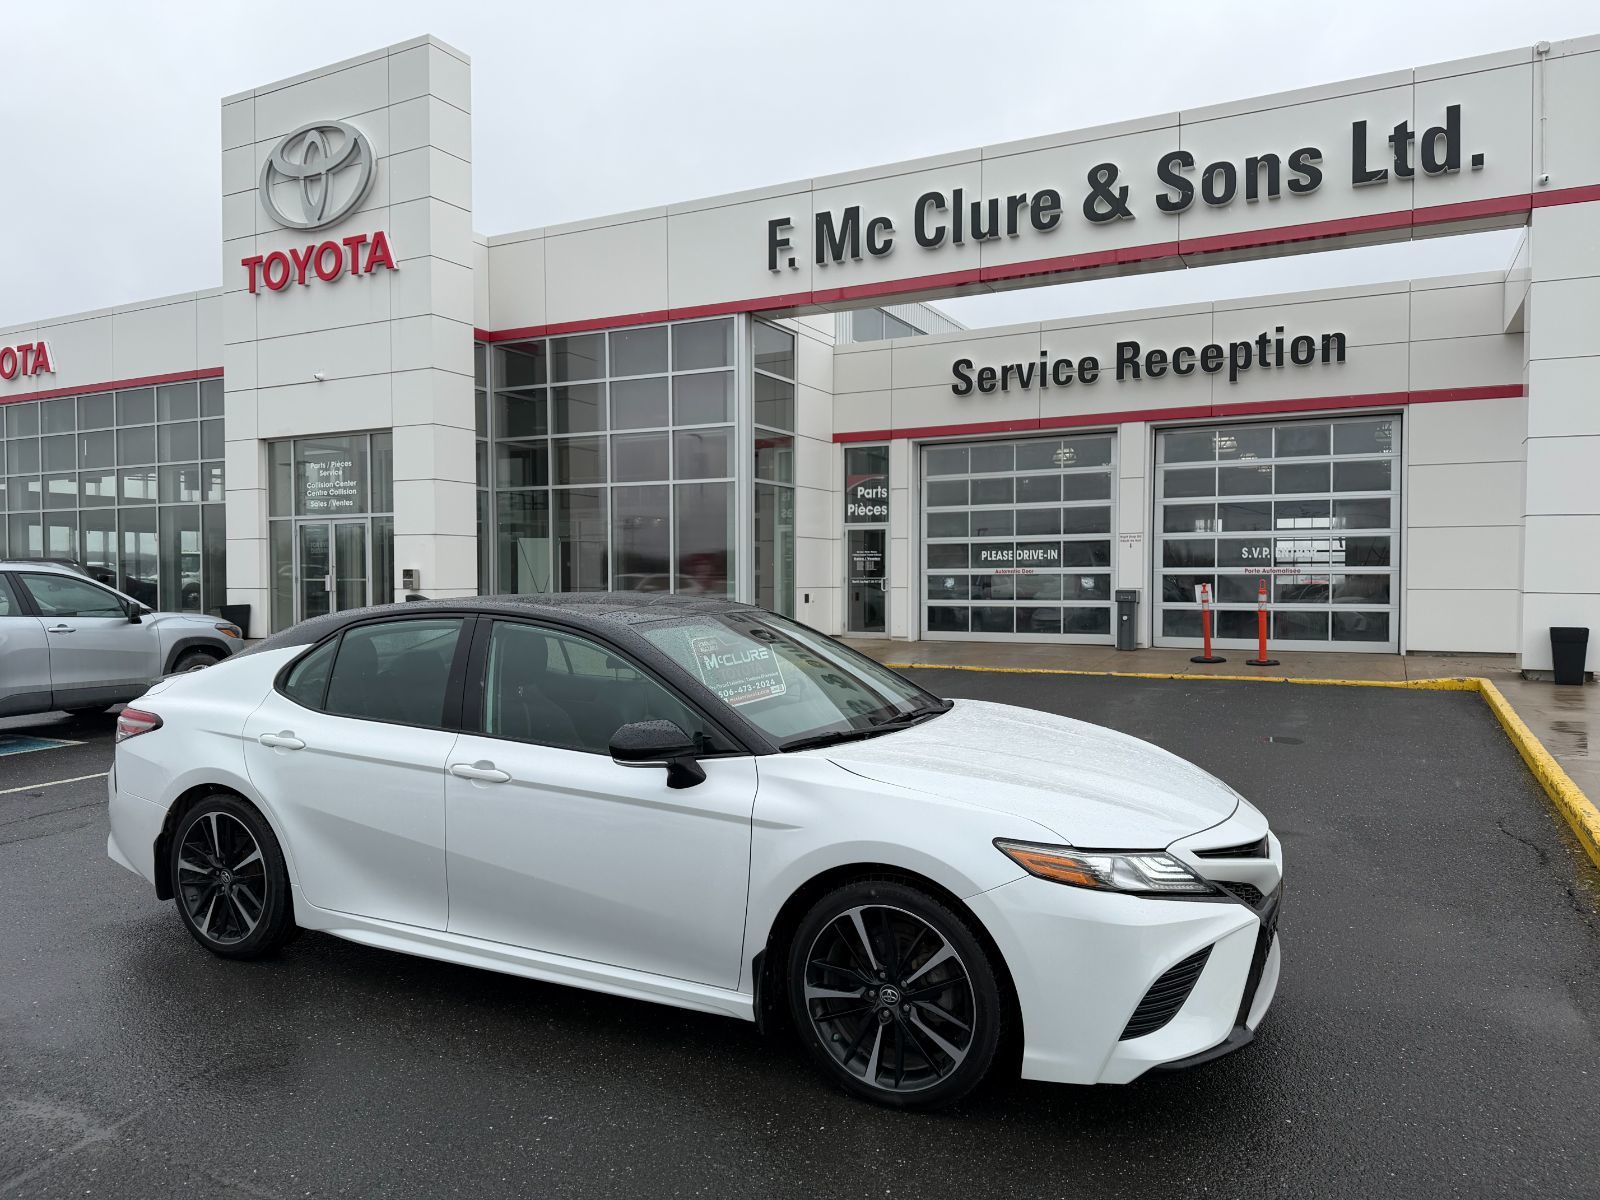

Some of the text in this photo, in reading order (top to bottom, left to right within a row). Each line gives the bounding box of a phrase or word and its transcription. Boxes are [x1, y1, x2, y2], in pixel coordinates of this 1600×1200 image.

[768, 104, 1484, 272] F. Mc Clure & Sons Ltd.
[241, 230, 397, 294] TOYOTA
[0, 341, 54, 380] OTA
[951, 326, 1347, 396] Service Reception
[331, 460, 352, 468] Pièces
[306, 481, 334, 489] Collision
[857, 485, 888, 499] Parts
[847, 502, 888, 516] Pièces
[981, 549, 1058, 561] PLEASE DRIVE-IN
[1241, 547, 1270, 559] S.V.P.
[718, 678, 776, 698] 506-473-2024
